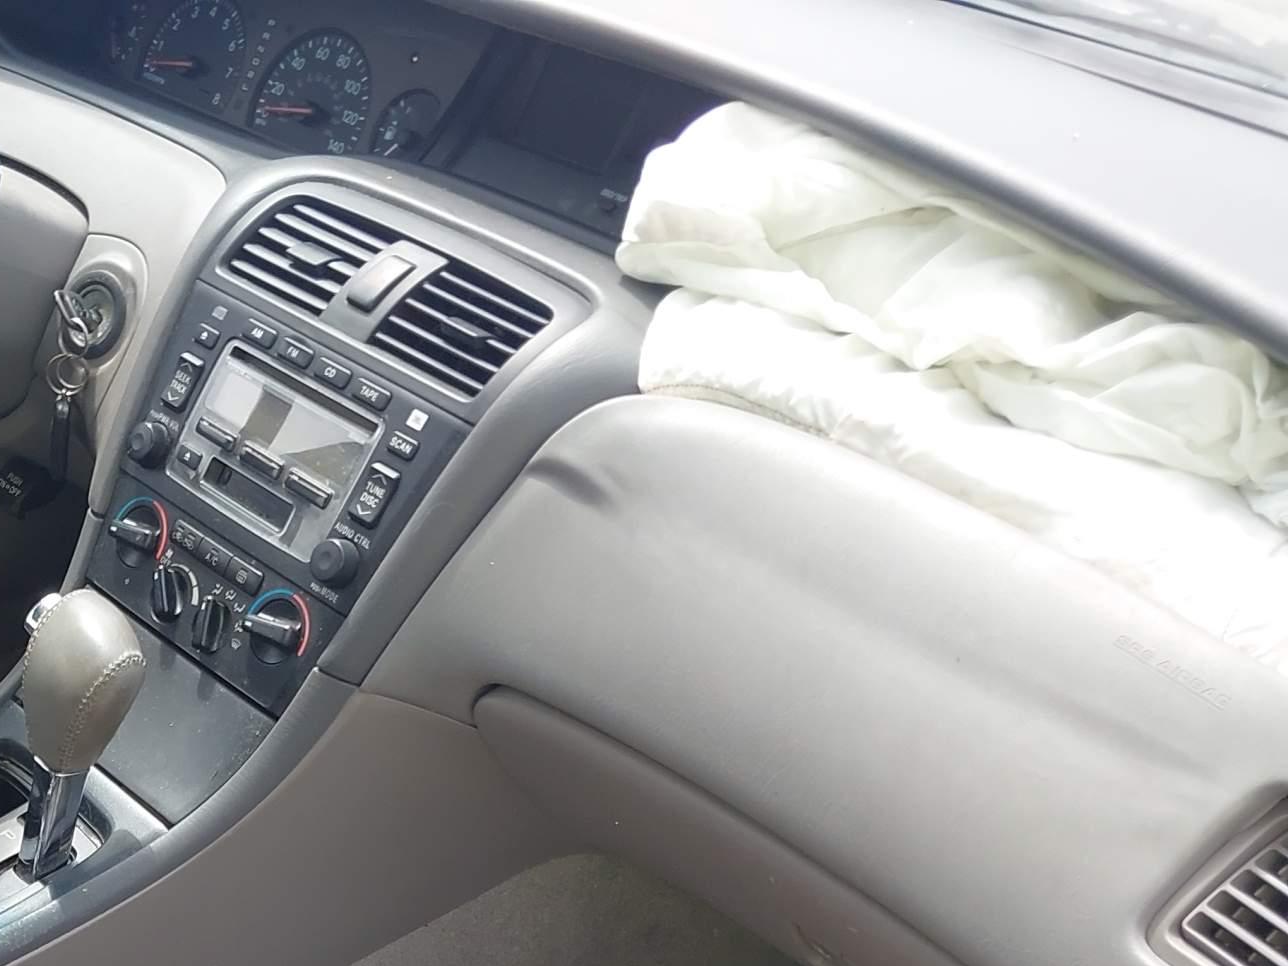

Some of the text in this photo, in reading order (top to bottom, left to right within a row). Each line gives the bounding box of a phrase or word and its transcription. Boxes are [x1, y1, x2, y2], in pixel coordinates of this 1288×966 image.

[315, 47, 330, 60] 60
[291, 56, 306, 71] 40
[335, 54, 351, 69] 80
[271, 82, 285, 96] 20
[344, 79, 361, 95] 100
[341, 110, 359, 126] 120
[328, 139, 345, 154] 140
[250, 327, 264, 339] AM
[286, 346, 300, 358] FM
[175, 369, 191, 385] SEEK
[324, 366, 336, 378] CD
[359, 385, 380, 402] TAPE
[389, 436, 413, 454] SCAN
[366, 481, 386, 499] TUNE
[360, 491, 379, 508] DISC
[334, 521, 371, 550] AUDIO CTRL
[0, 829, 16, 840] P
